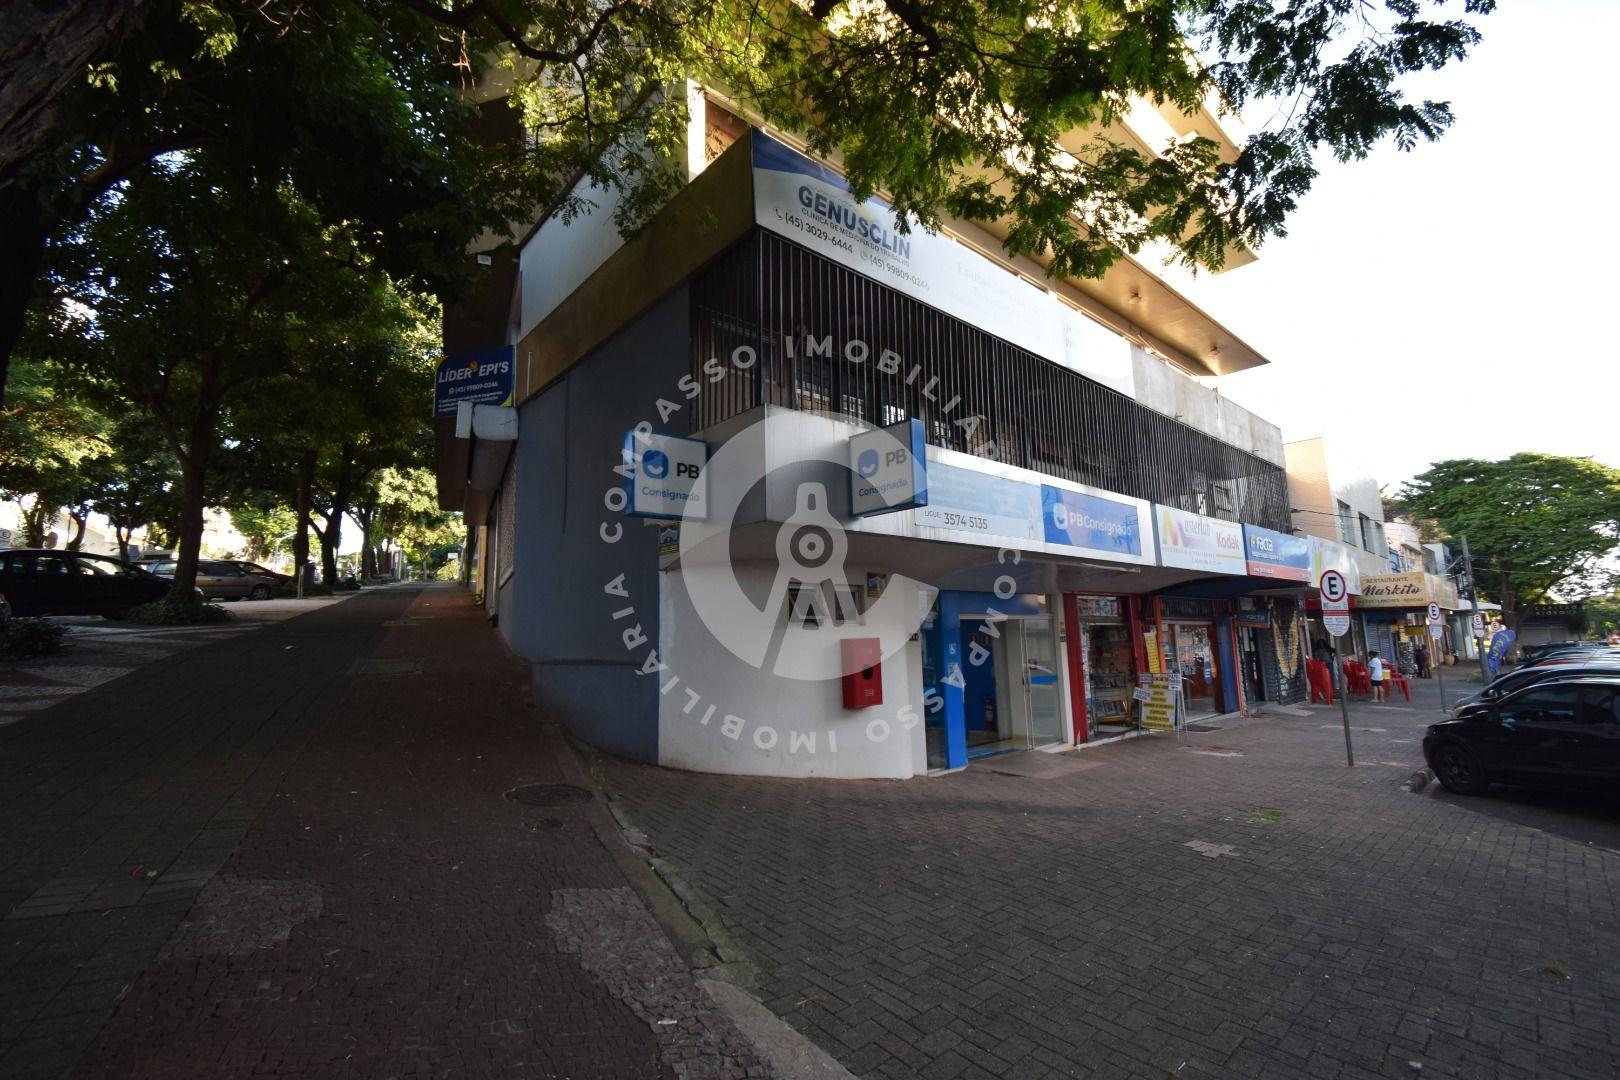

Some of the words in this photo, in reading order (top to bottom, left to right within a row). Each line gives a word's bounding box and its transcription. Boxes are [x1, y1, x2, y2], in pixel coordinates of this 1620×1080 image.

[799, 186, 911, 260] GENUSCLIN
[785, 211, 805, 232] (45)
[805, 222, 853, 254] 3029-6444
[869, 254, 885, 271] (45)
[438, 368, 472, 383] LÍDER
[479, 361, 509, 377] EPI'S
[885, 448, 907, 468] PB
[676, 462, 700, 479] PB
[641, 486, 701, 502] Consignado
[858, 478, 908, 498] Consignado
[944, 512, 967, 526] 3574
[969, 518, 988, 530] 5135
[1216, 531, 1239, 551] Kodak
[1327, 576, 1339, 595] E
[1366, 576, 1409, 584] RESTAURANTE
[1361, 583, 1422, 596] Markito
[1431, 605, 1437, 616] E
